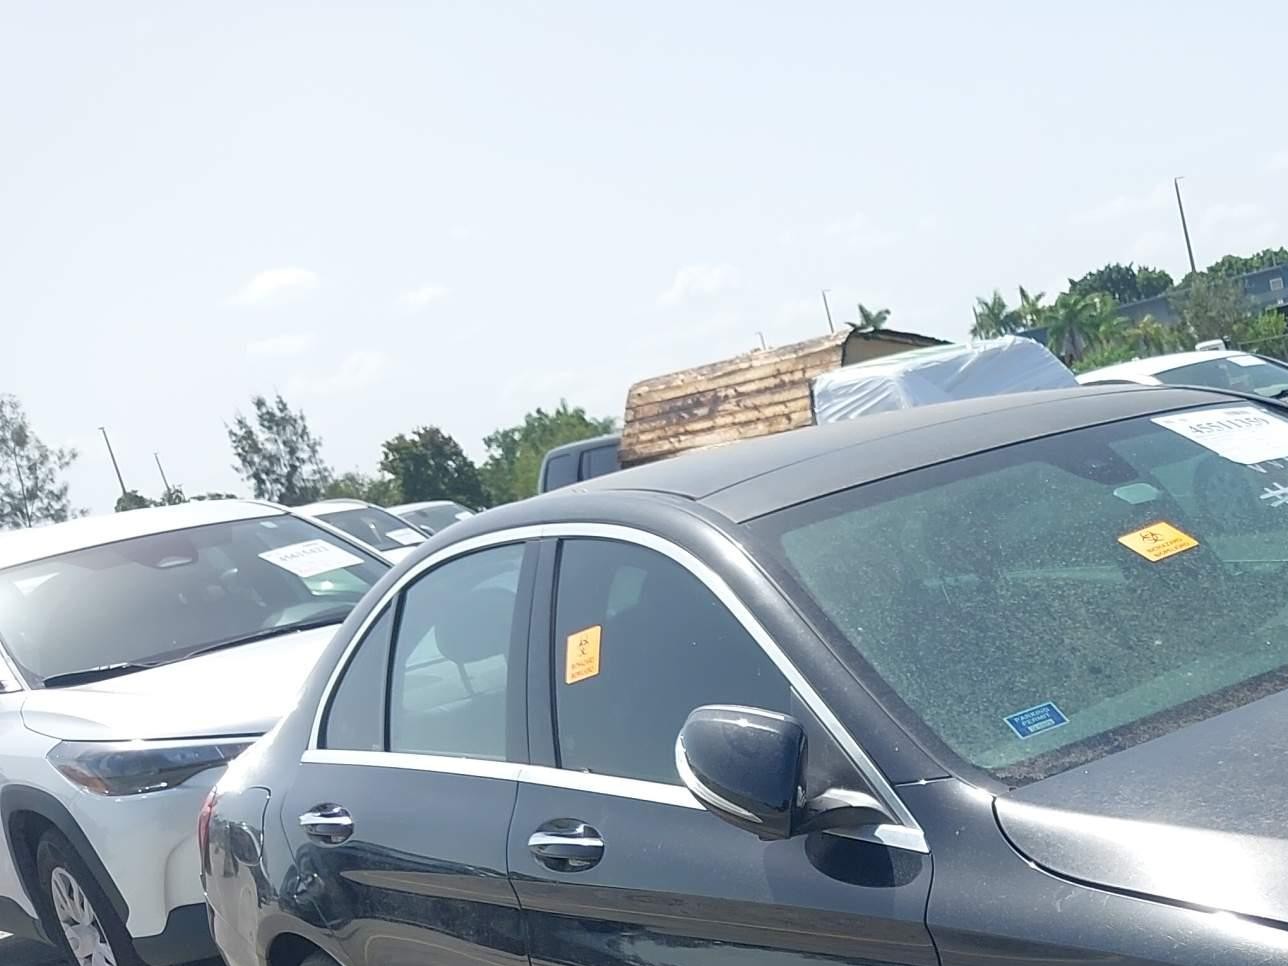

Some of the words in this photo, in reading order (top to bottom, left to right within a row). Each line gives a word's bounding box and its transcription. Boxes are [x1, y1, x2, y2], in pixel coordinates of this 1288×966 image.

[1188, 416, 1270, 434] 45511359
[1013, 706, 1050, 723] PARKING
[1021, 712, 1050, 727] PERMIT
